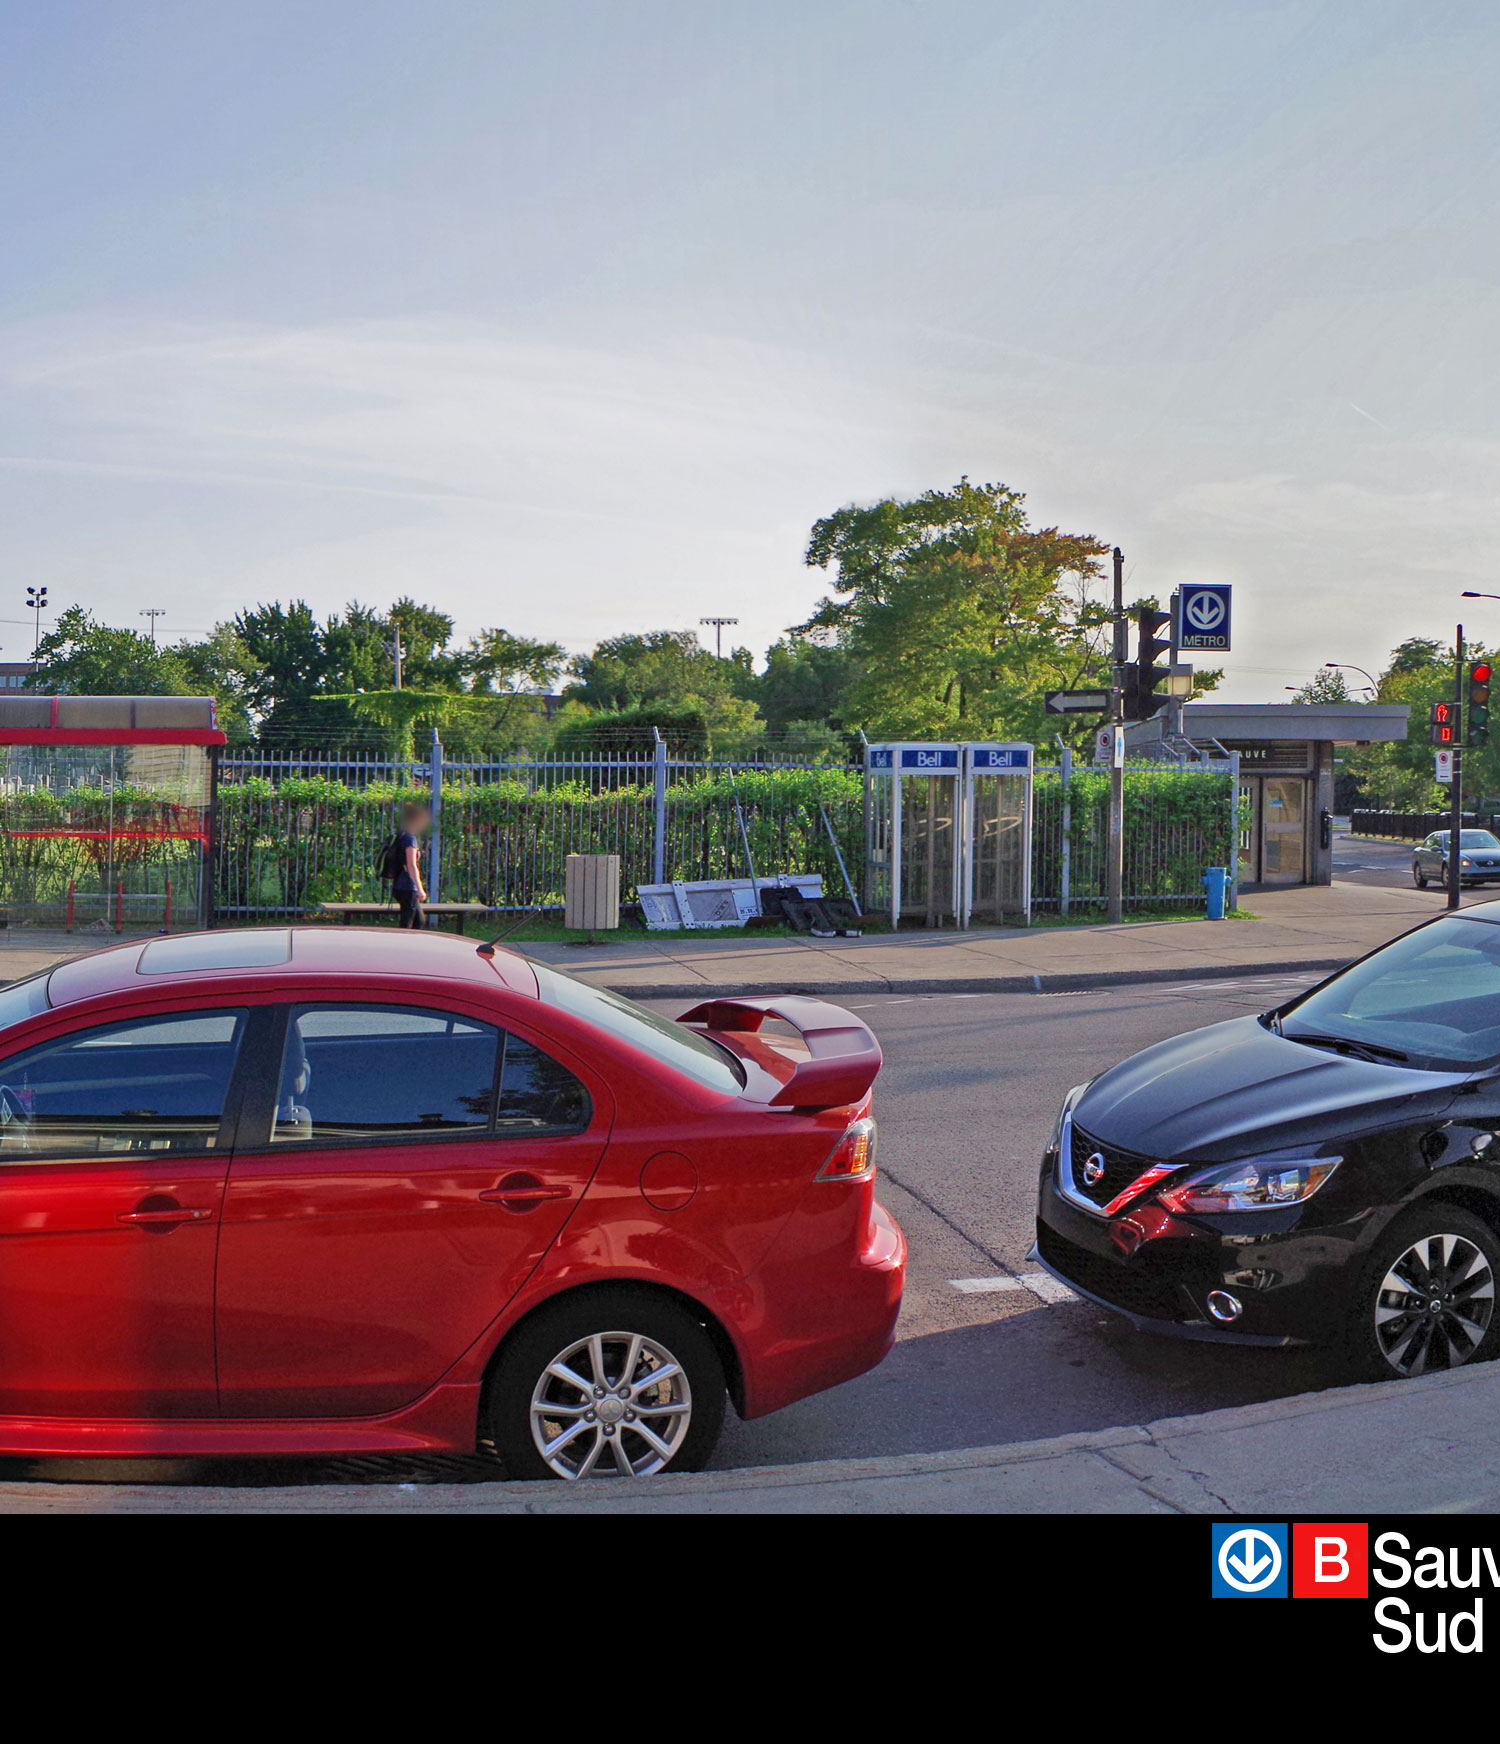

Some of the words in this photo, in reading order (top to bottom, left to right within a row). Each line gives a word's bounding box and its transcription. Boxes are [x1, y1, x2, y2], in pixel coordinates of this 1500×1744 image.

[917, 751, 942, 767] Bell
[989, 751, 1012, 767] Bell
[1239, 750, 1266, 759] AUVE
